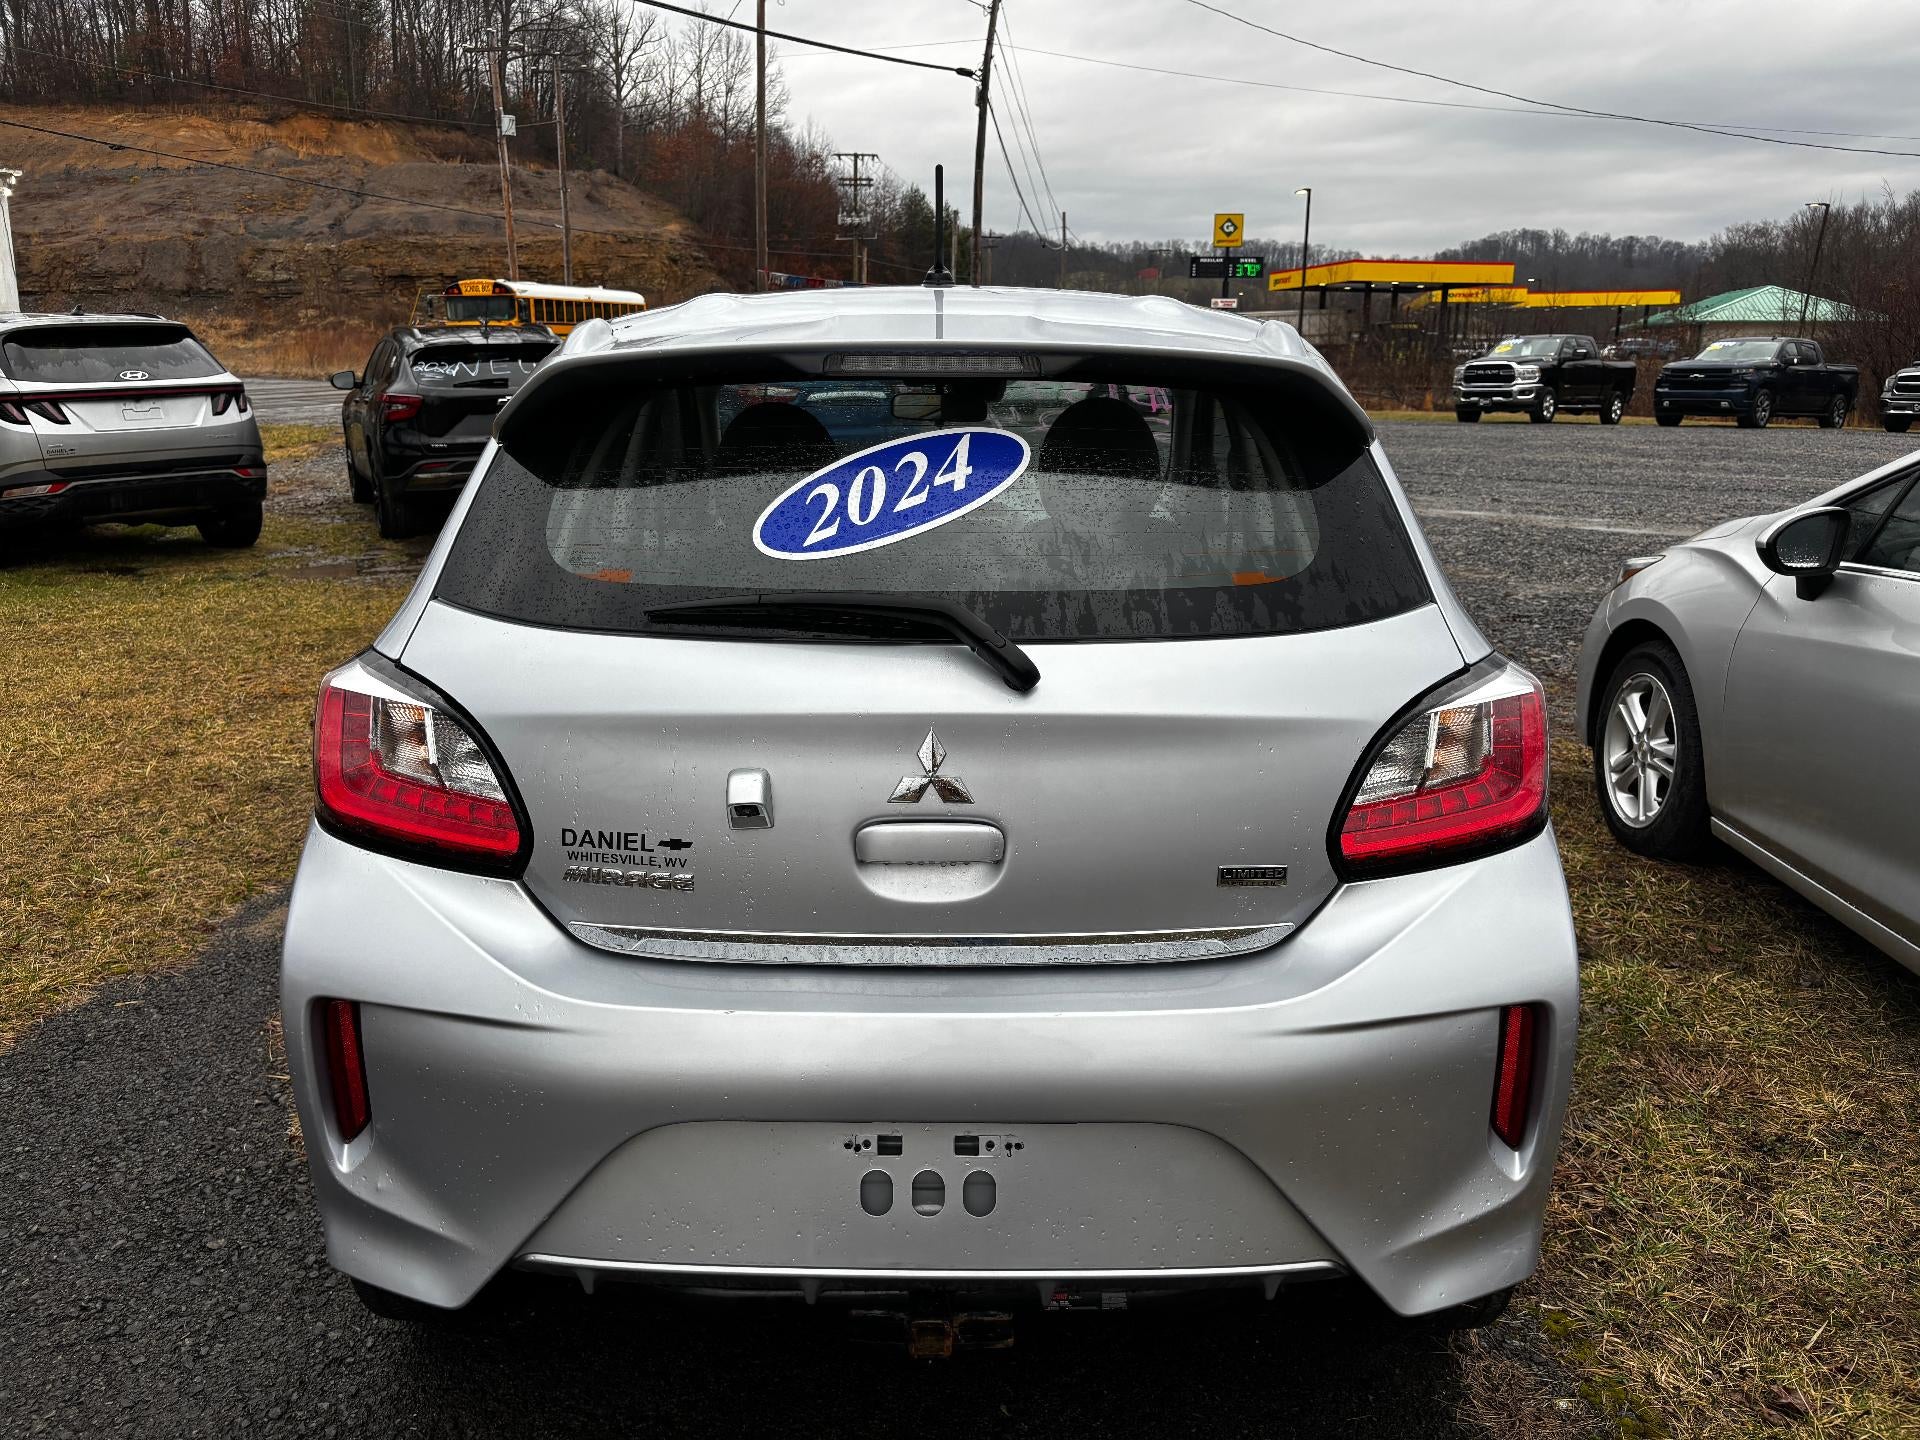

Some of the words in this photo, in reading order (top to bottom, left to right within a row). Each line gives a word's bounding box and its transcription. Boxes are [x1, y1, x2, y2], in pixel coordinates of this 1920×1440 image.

[803, 433, 973, 547] 2024
[561, 828, 655, 852] DANIEL
[567, 850, 662, 868] WHITESVILLE,
[664, 856, 688, 868] WV
[562, 865, 695, 892] MIRAGE
[1223, 868, 1285, 878] LIMITED
